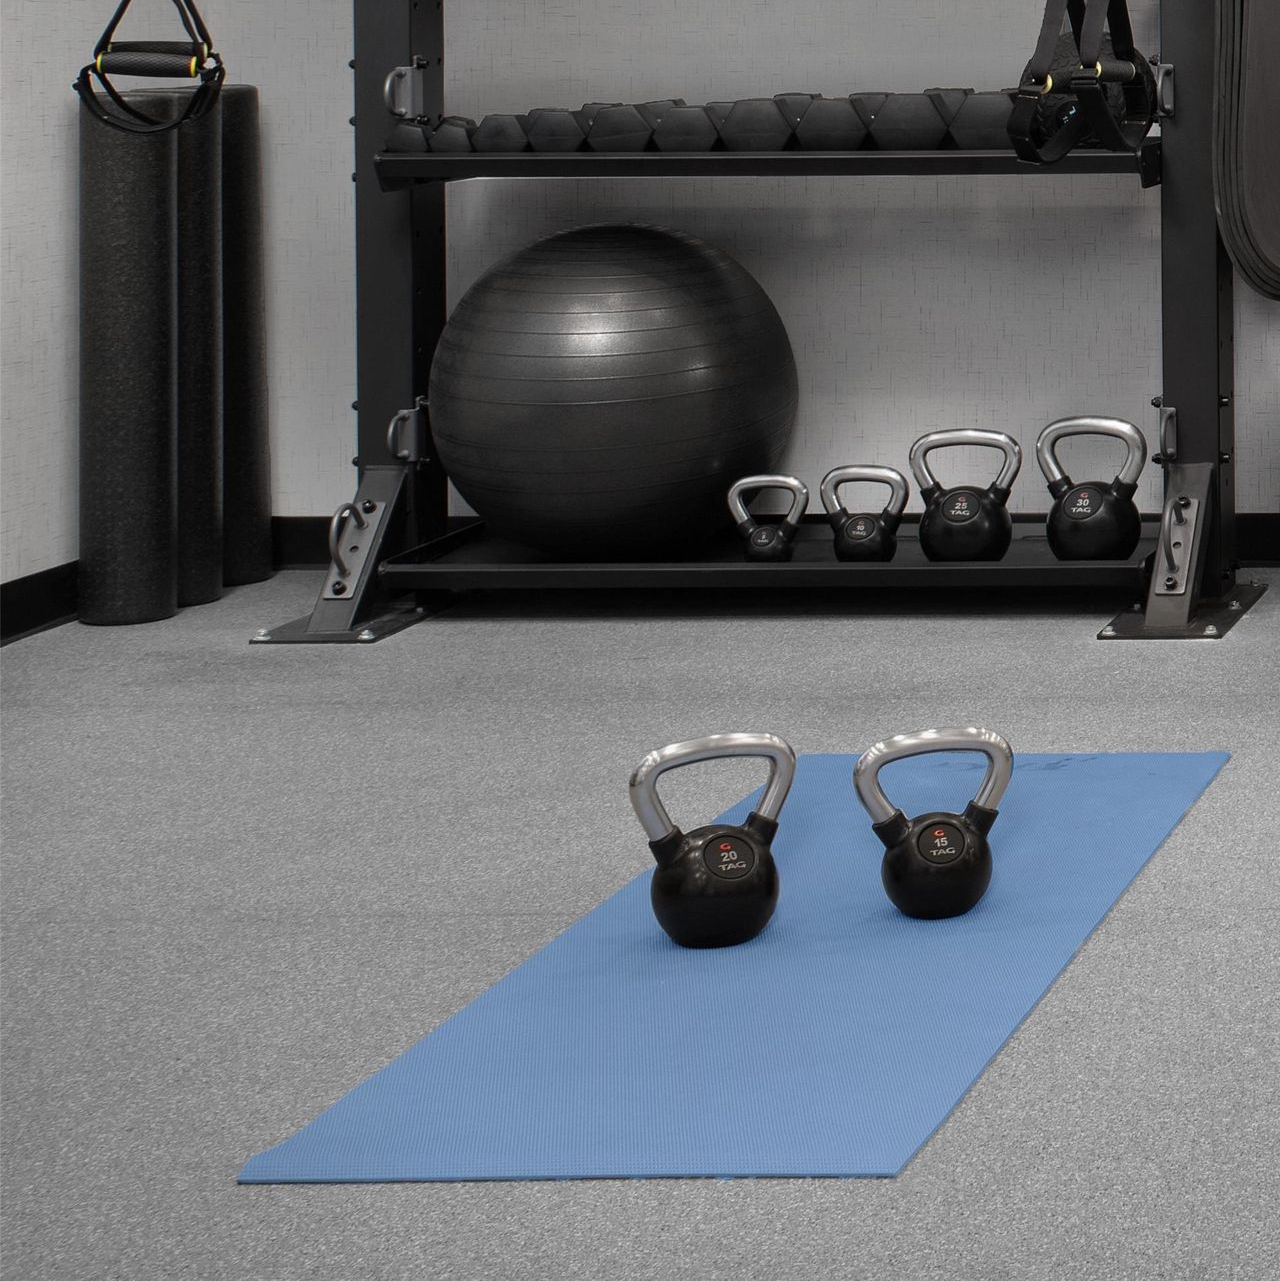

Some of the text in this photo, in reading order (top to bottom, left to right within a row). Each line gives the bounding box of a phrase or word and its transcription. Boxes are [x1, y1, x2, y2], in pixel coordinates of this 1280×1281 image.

[954, 502, 968, 510] 25
[1076, 498, 1090, 507] 30
[1071, 506, 1092, 514] TAG
[934, 837, 949, 847] 15
[930, 847, 956, 856] TAG
[720, 850, 738, 863] 20
[718, 860, 748, 871] TAG
